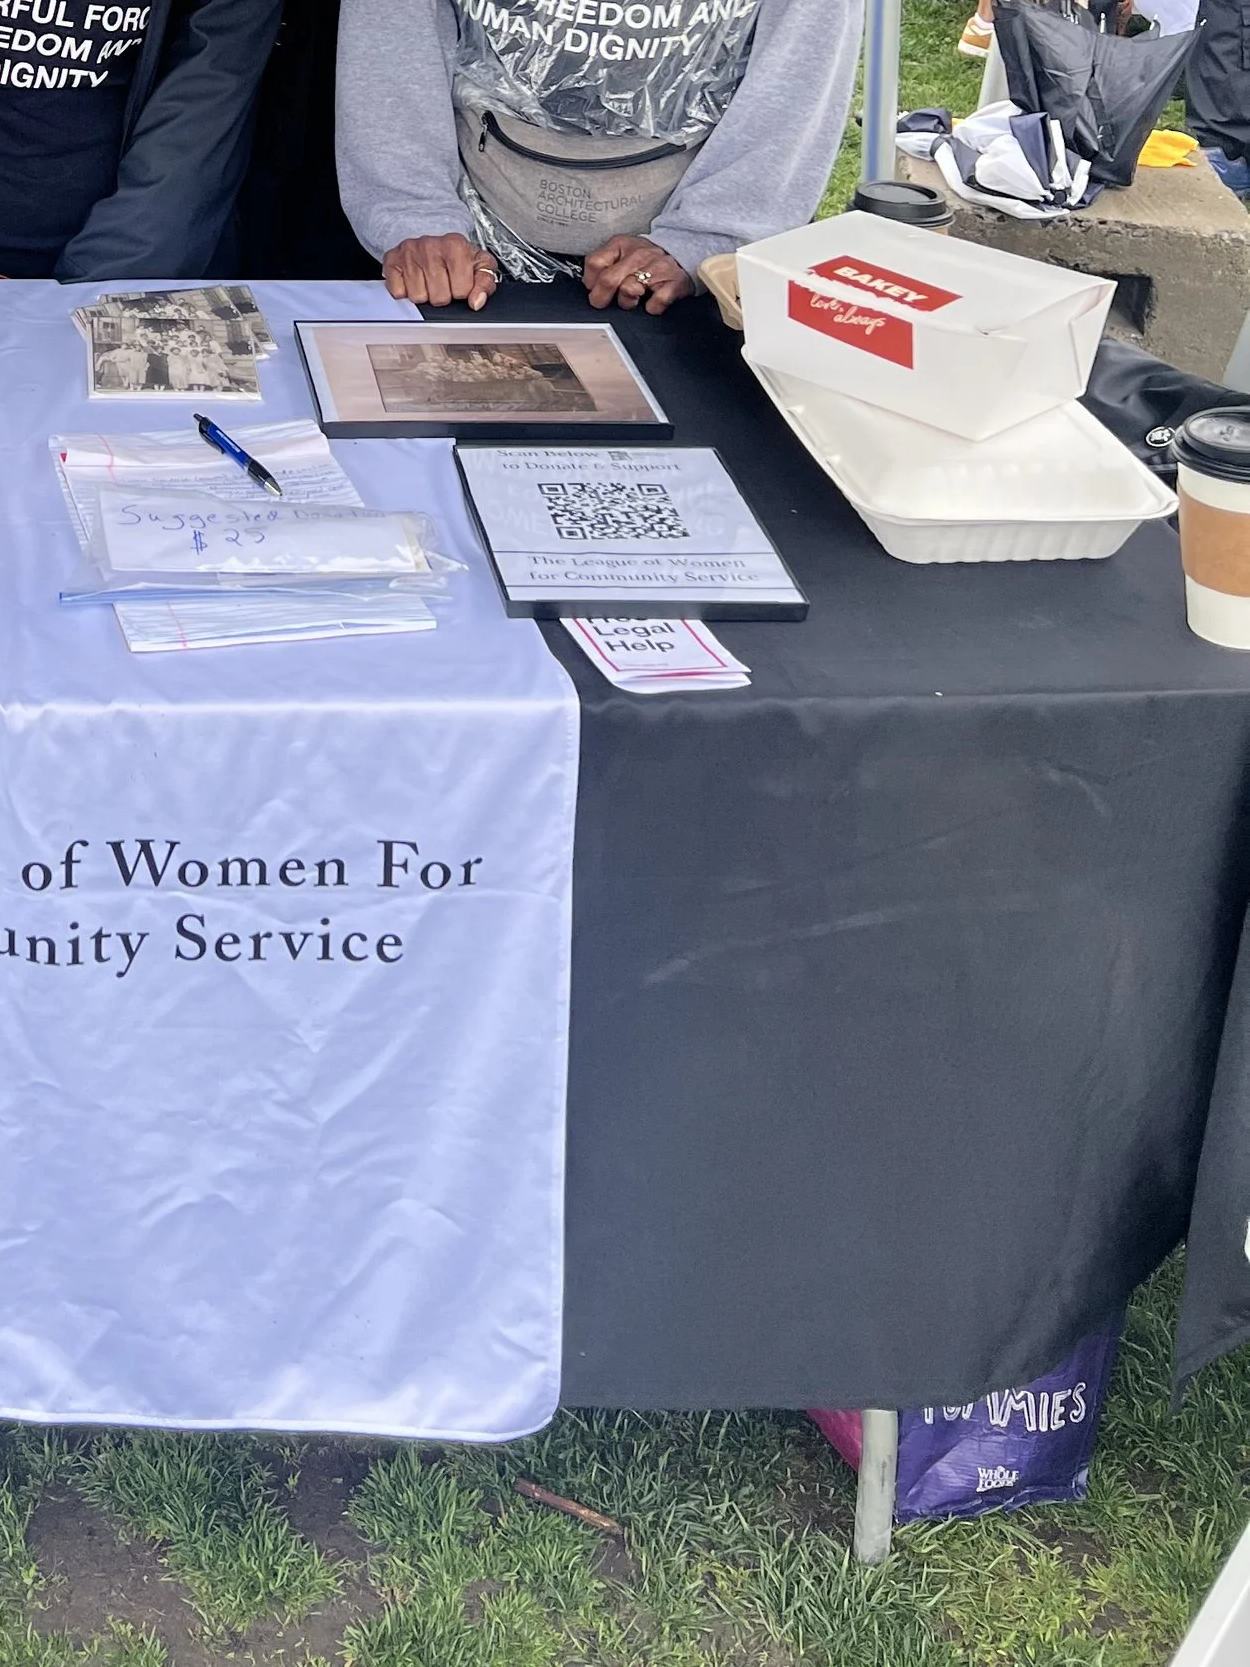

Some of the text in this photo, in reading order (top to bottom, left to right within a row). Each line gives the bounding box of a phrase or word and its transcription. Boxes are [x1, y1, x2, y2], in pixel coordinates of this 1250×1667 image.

[564, 28, 700, 61] DIGNITY
[539, 179, 591, 199] BOSTON
[538, 191, 645, 212] ARCHITECTURAL
[536, 201, 596, 223] COLLEGE
[833, 266, 929, 302] BAKEY
[497, 449, 598, 458] Scan Below
[502, 462, 519, 470] to
[526, 461, 588, 470] Donate
[611, 462, 682, 472] Support
[528, 555, 746, 568] The League of Women
[530, 571, 760, 583] for Community Service
[593, 622, 676, 637] Legal
[605, 639, 675, 652] Help
[21, 839, 90, 891] of
[105, 838, 349, 888] Women
[376, 839, 483, 890] For
[175, 913, 404, 963] Service
[977, 1466, 1020, 1481] WHOLE
